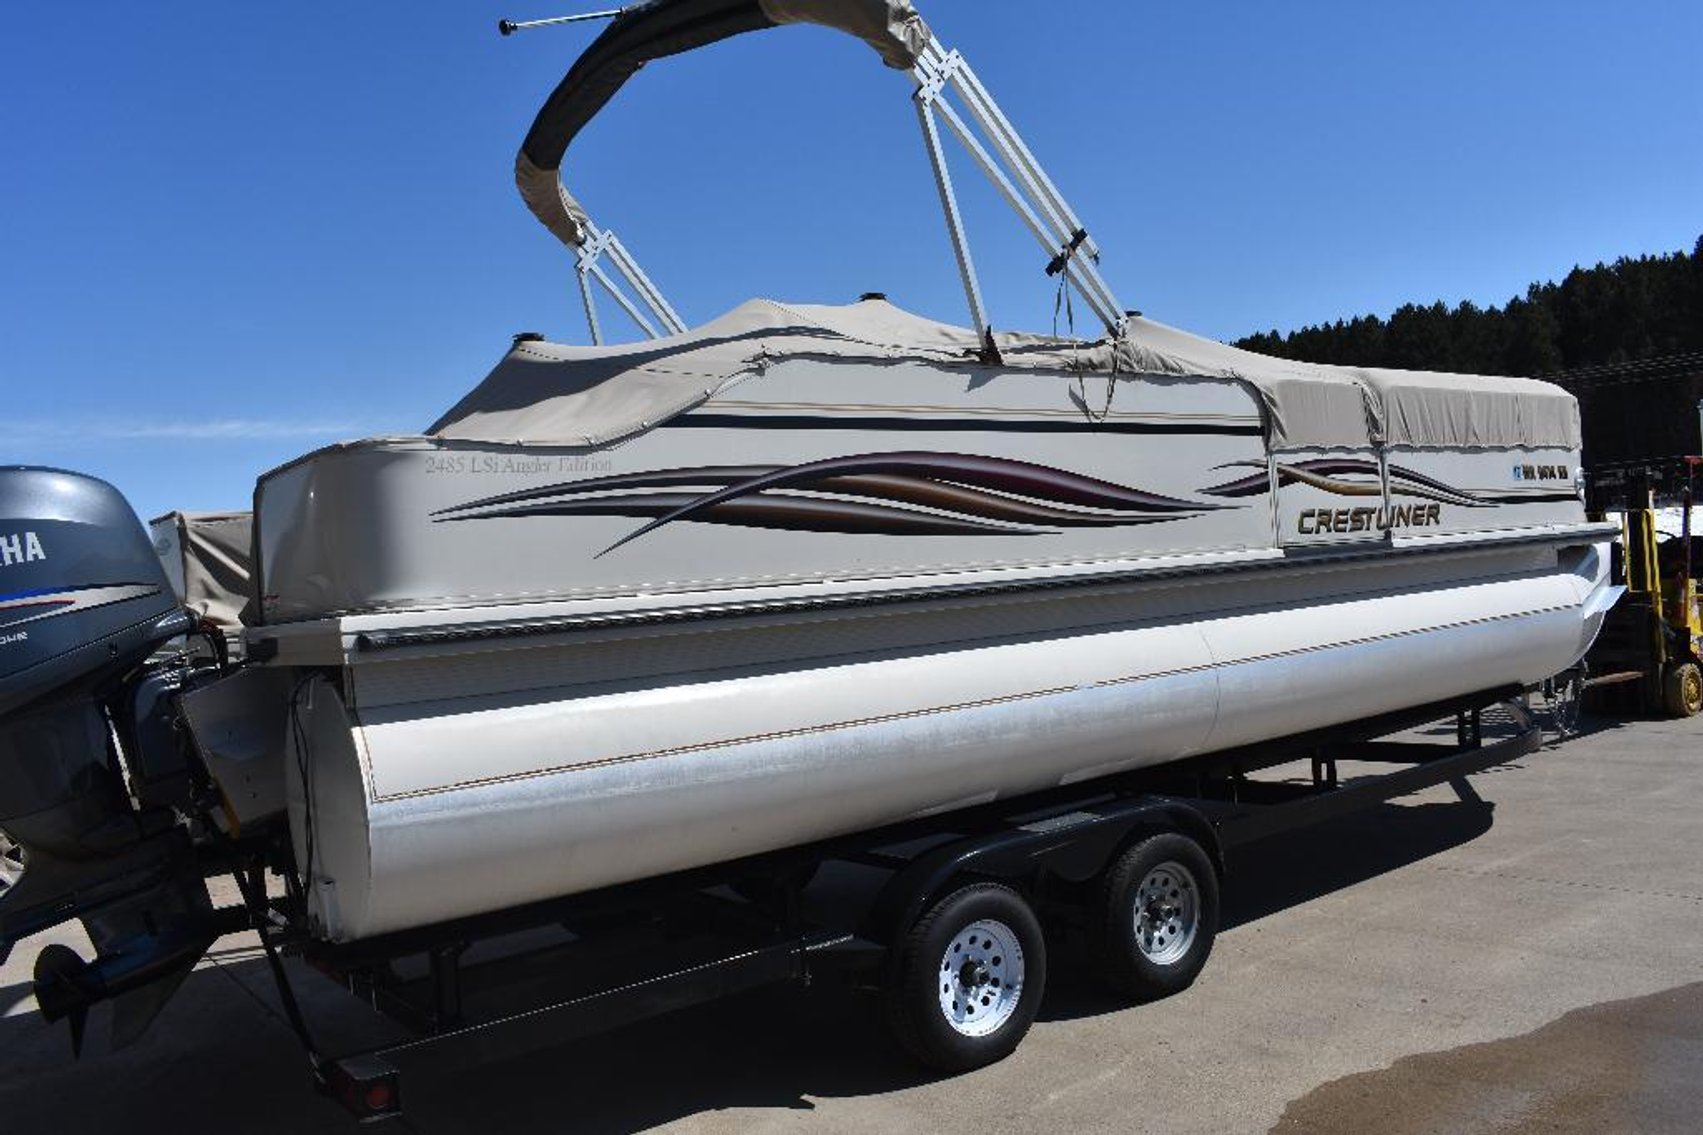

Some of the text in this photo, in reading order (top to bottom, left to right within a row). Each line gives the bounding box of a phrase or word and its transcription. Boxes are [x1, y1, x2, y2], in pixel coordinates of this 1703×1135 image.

[425, 456, 465, 474] 2485
[471, 456, 499, 473] LSi
[1298, 502, 1441, 535] CRESTLINER
[0, 531, 46, 566] HA
